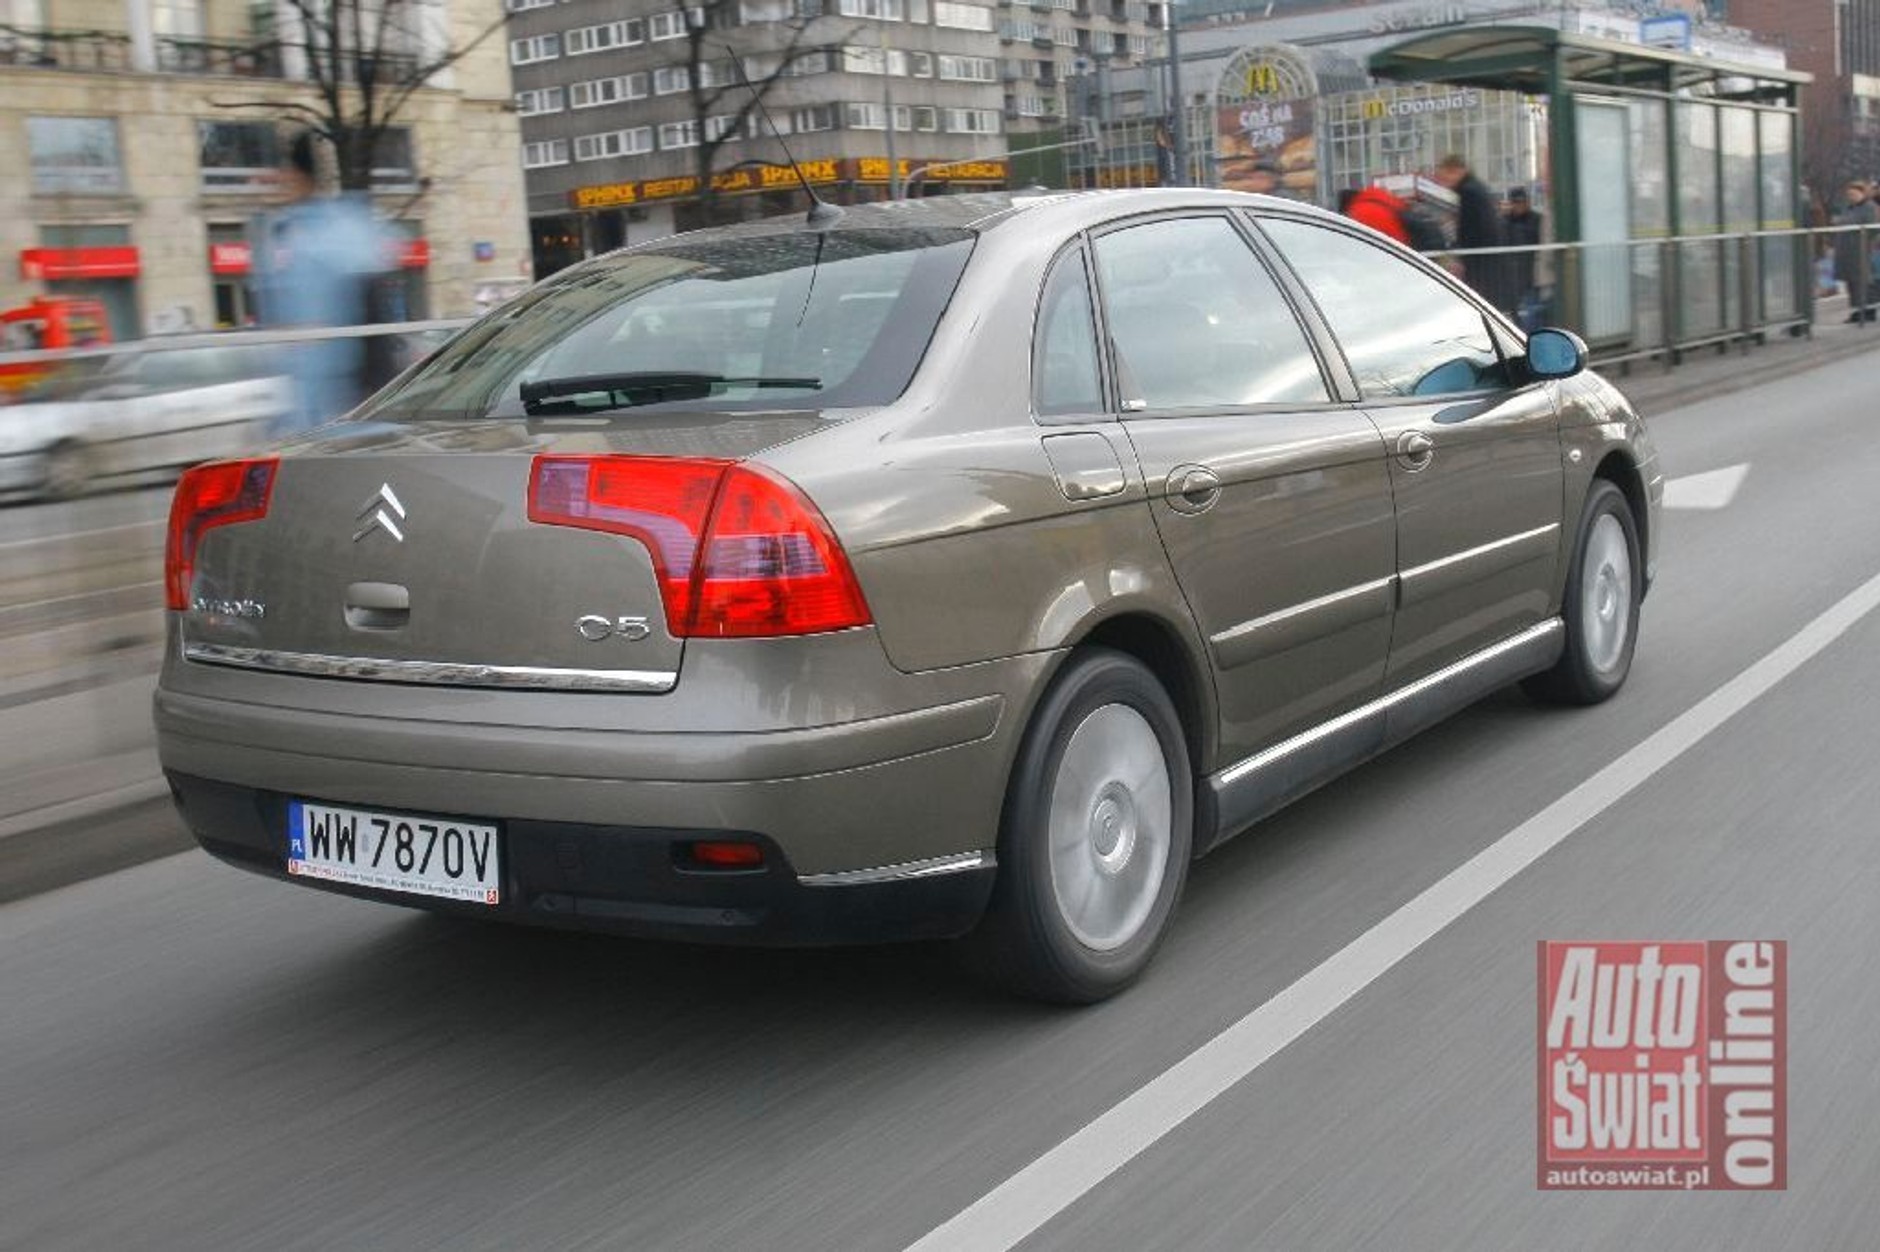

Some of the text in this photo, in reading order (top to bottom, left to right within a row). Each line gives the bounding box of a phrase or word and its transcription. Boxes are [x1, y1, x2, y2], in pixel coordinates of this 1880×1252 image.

[575, 614, 650, 641] C5
[291, 839, 303, 853] PL
[309, 811, 357, 864] WW
[371, 818, 490, 882] 7870V
